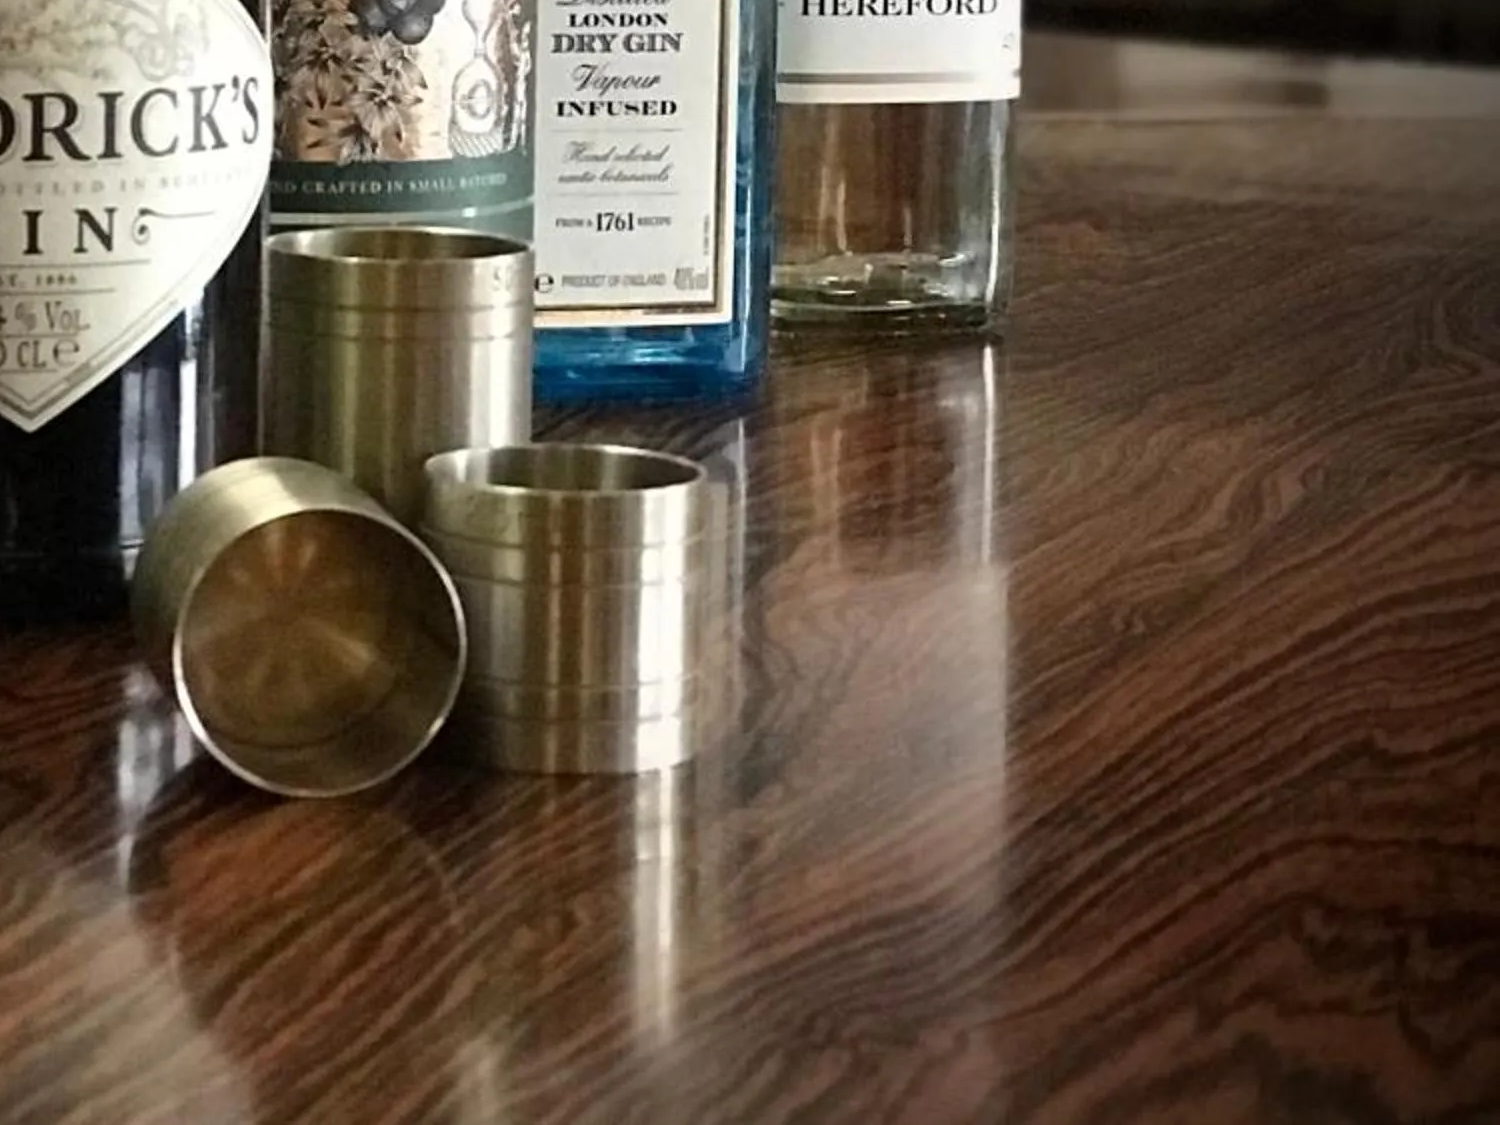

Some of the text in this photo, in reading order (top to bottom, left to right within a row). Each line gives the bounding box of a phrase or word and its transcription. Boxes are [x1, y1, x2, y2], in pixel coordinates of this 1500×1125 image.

[569, 12, 669, 28] LONDON
[551, 32, 684, 54] DRY GIN
[570, 63, 662, 97] Vapour
[556, 100, 678, 118] INFUSED
[120, 178, 145, 192] IN
[302, 180, 381, 195] CRAFTED
[387, 179, 404, 194] IN
[409, 177, 455, 192] SMALL
[596, 212, 634, 232] 1761
